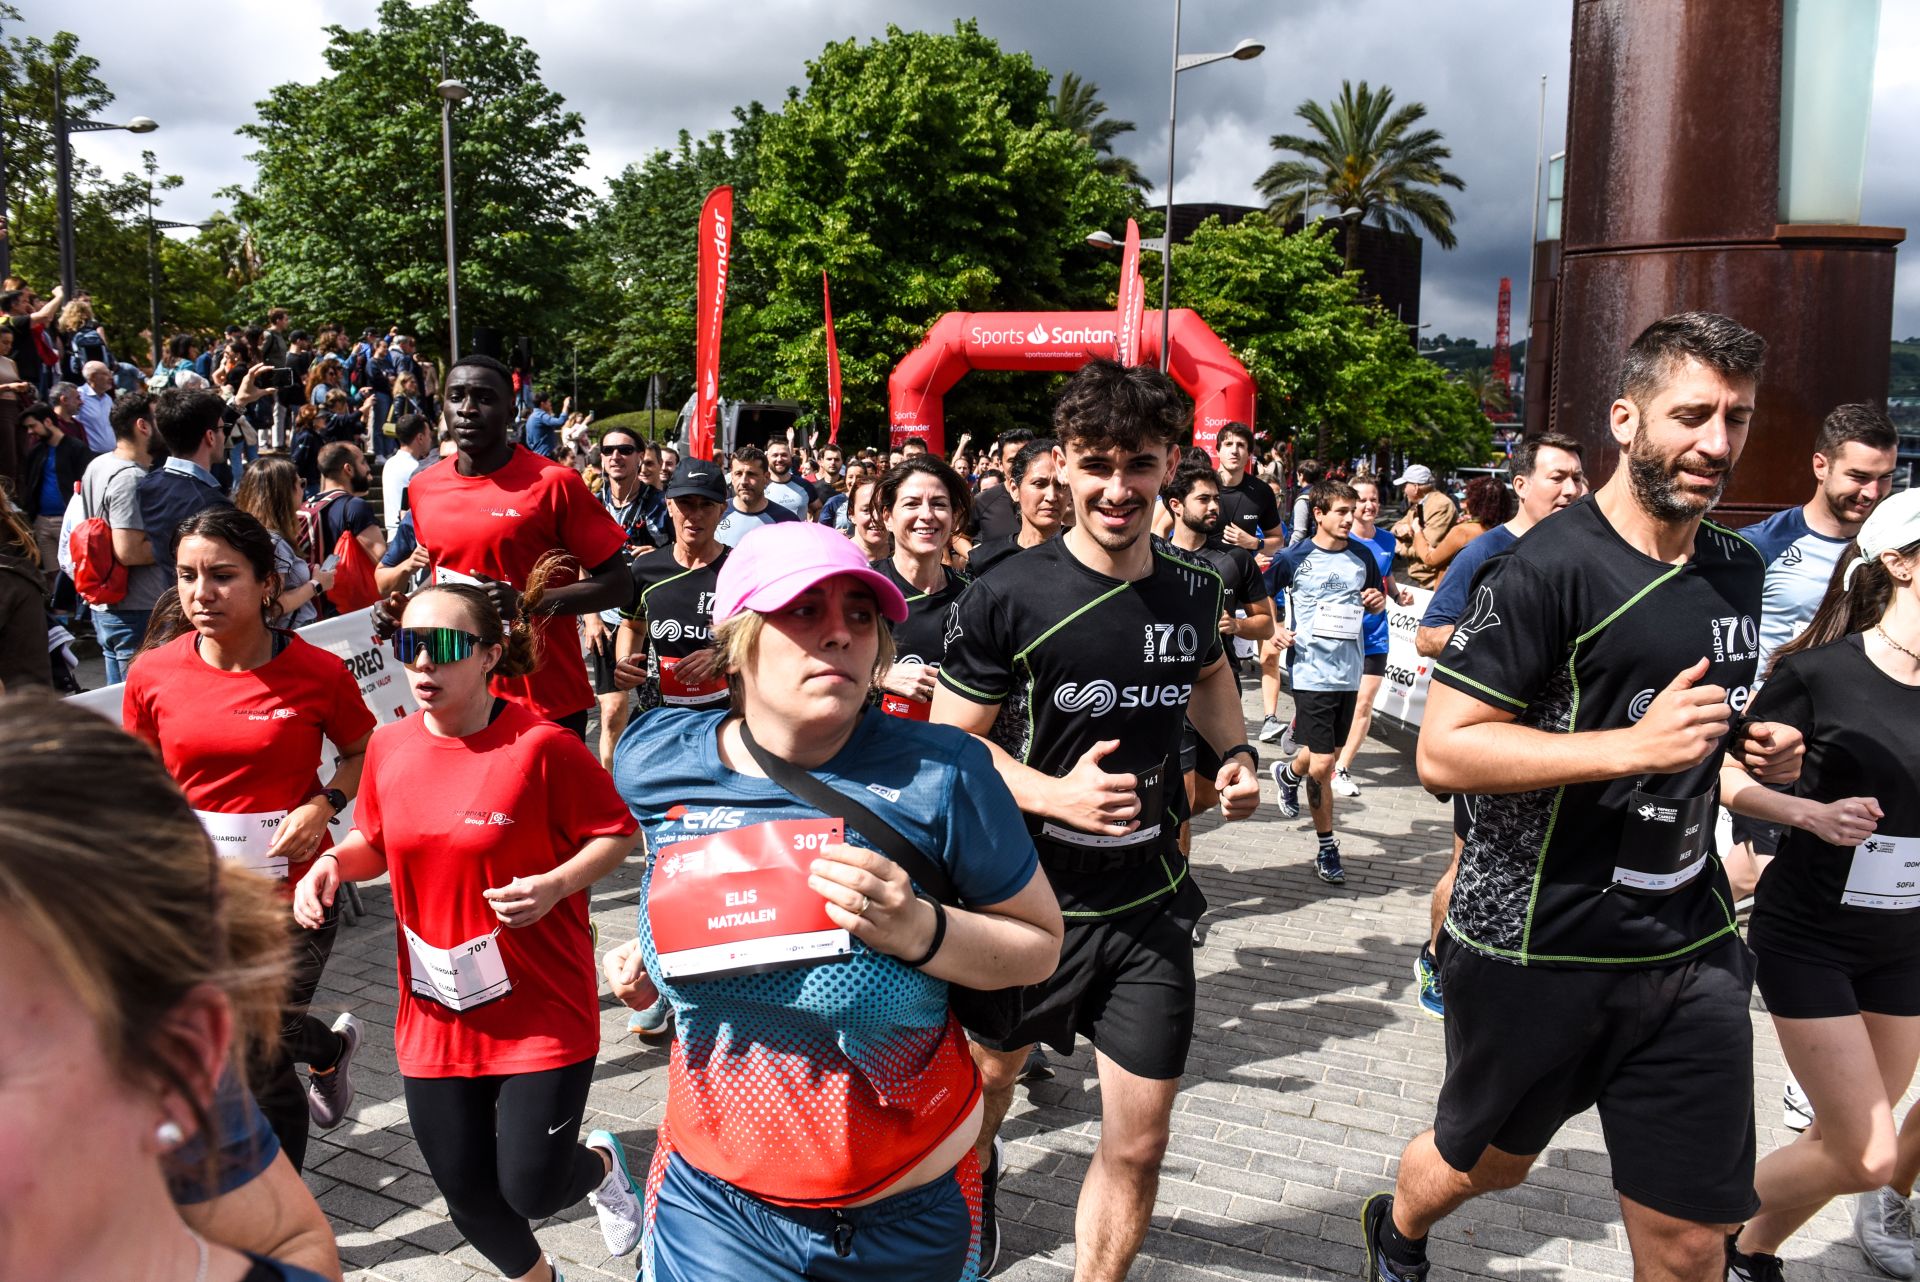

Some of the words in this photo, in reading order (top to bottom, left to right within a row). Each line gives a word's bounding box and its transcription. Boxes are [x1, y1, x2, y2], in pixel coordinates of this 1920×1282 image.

[971, 327, 1024, 348] Sports
[1051, 327, 1115, 344] Santan
[1025, 351, 1083, 359] sportssantander.es
[895, 411, 917, 421] Sports
[1320, 582, 1348, 590] AFESA
[697, 591, 706, 614] bilbao
[1154, 623, 1198, 656] 70
[1711, 619, 1725, 662] bilbao
[1719, 615, 1758, 654] 70
[1144, 624, 1154, 663] bilbao
[1729, 653, 1744, 662] 1954
[1119, 684, 1192, 708] suez
[1144, 774, 1158, 788] 141
[260, 818, 280, 828] 709
[464, 818, 485, 826] Group
[683, 806, 746, 829] elis
[211, 834, 247, 842] SUARDIAZ
[793, 833, 829, 850] 307
[1896, 881, 1915, 889] SOFIA
[725, 889, 758, 907] ELIS
[708, 908, 776, 930] MATXALEN
[467, 940, 487, 956] 709
